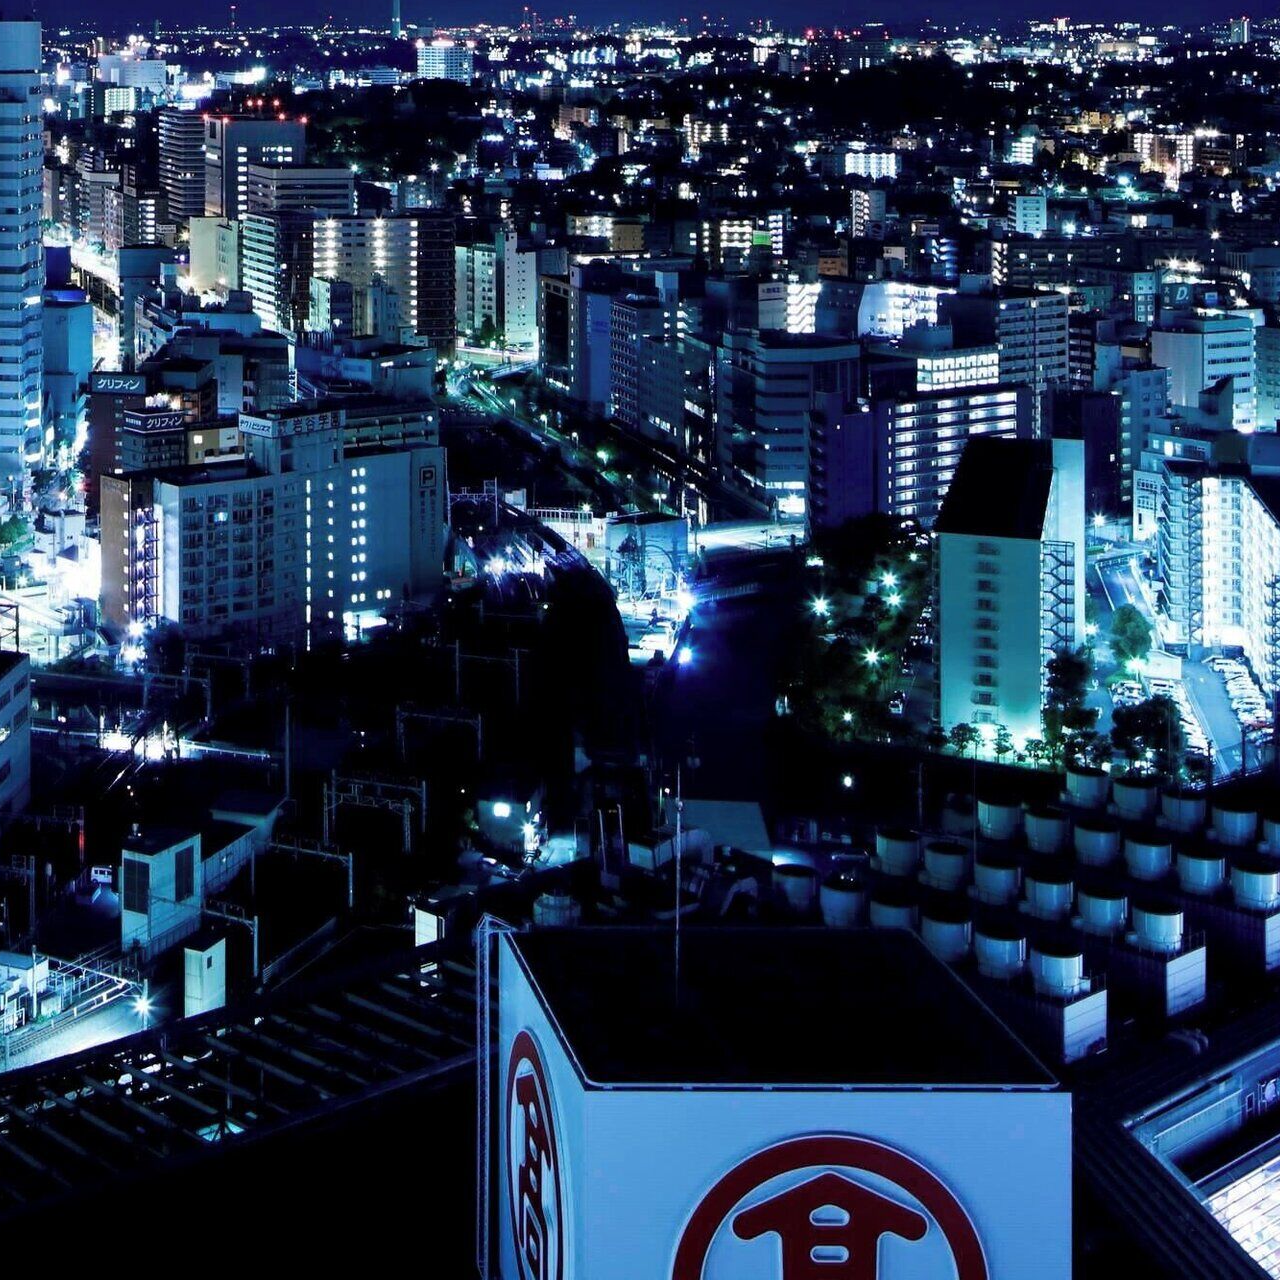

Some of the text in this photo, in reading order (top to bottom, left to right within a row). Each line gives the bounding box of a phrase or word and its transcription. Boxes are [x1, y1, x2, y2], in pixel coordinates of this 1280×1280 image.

[97, 378, 140, 390] グリフィン
[146, 416, 183, 428] グリフィン
